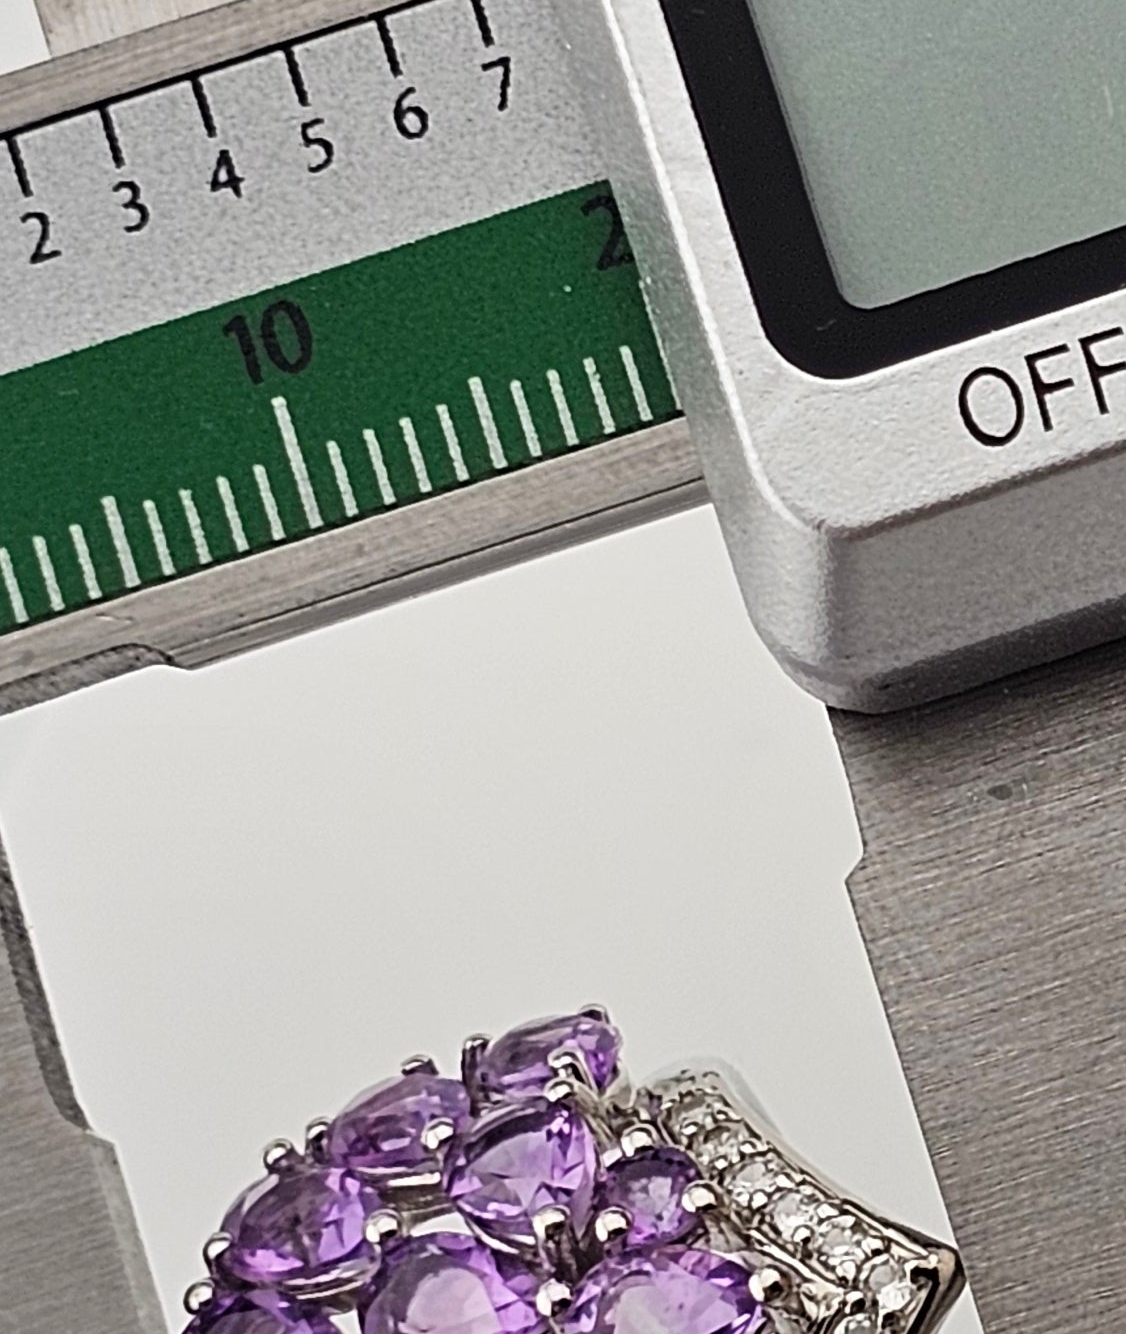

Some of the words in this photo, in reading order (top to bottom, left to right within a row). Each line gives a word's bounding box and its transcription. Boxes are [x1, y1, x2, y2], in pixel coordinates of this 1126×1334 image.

[20, 211, 62, 264] 2
[112, 180, 150, 233] 3
[208, 149, 246, 198] 4
[300, 118, 334, 172] 5
[393, 87, 429, 139] 6
[481, 56, 512, 111] 7
[222, 299, 313, 384] 10
[580, 195, 635, 271] 2
